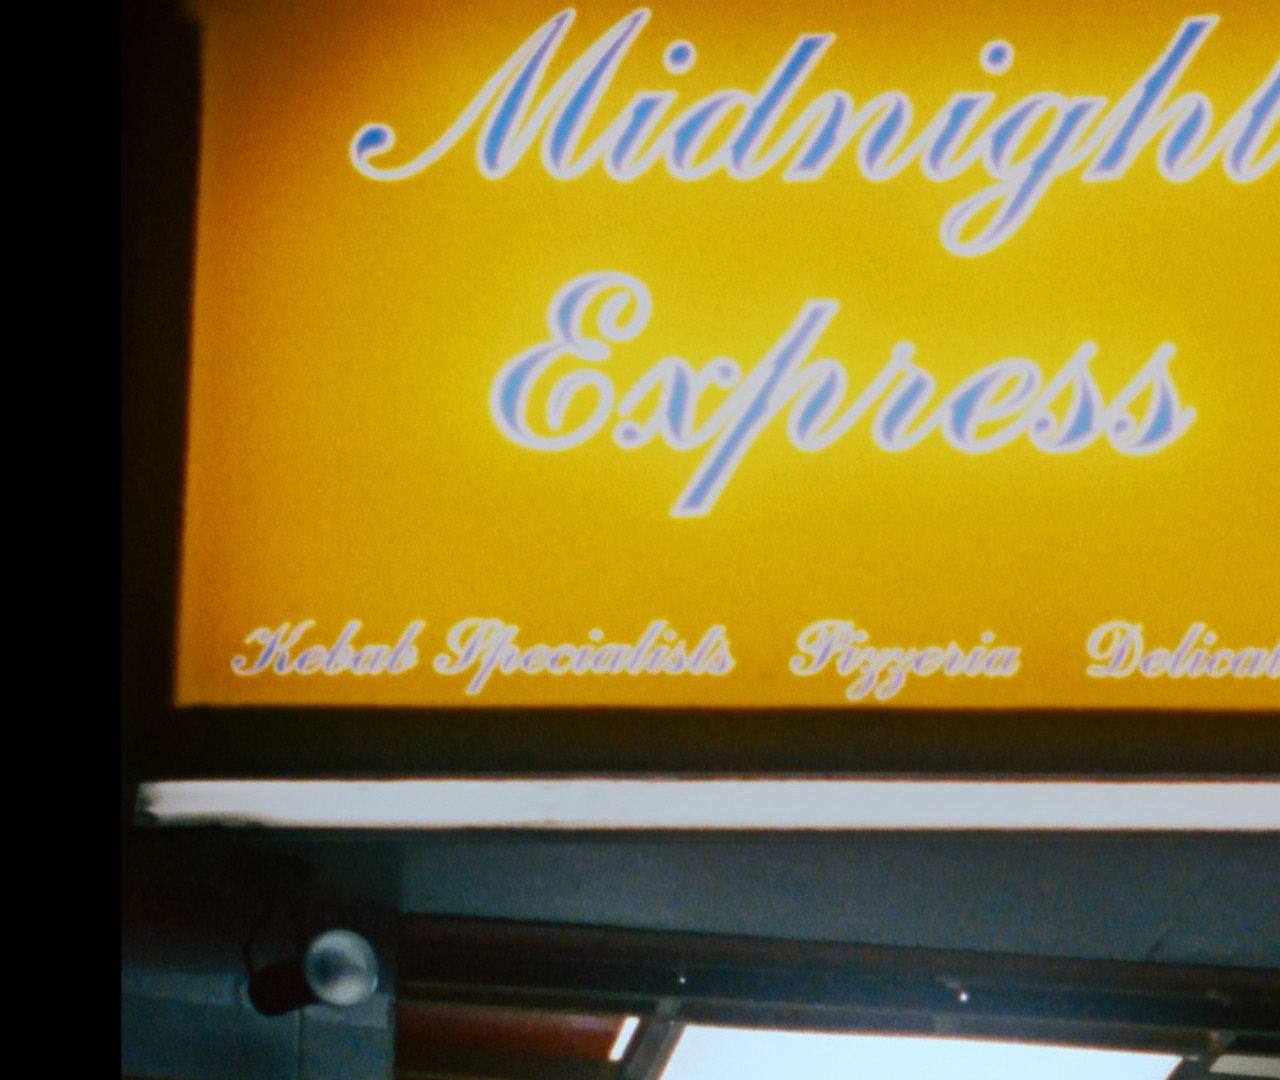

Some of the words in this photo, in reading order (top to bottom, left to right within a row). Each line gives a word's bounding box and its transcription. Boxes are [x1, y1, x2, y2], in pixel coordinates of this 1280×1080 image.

[489, 270, 1196, 518] Express
[232, 620, 424, 675] Kebab
[433, 618, 735, 695] Specialists
[789, 619, 1021, 701] Pizzeria
